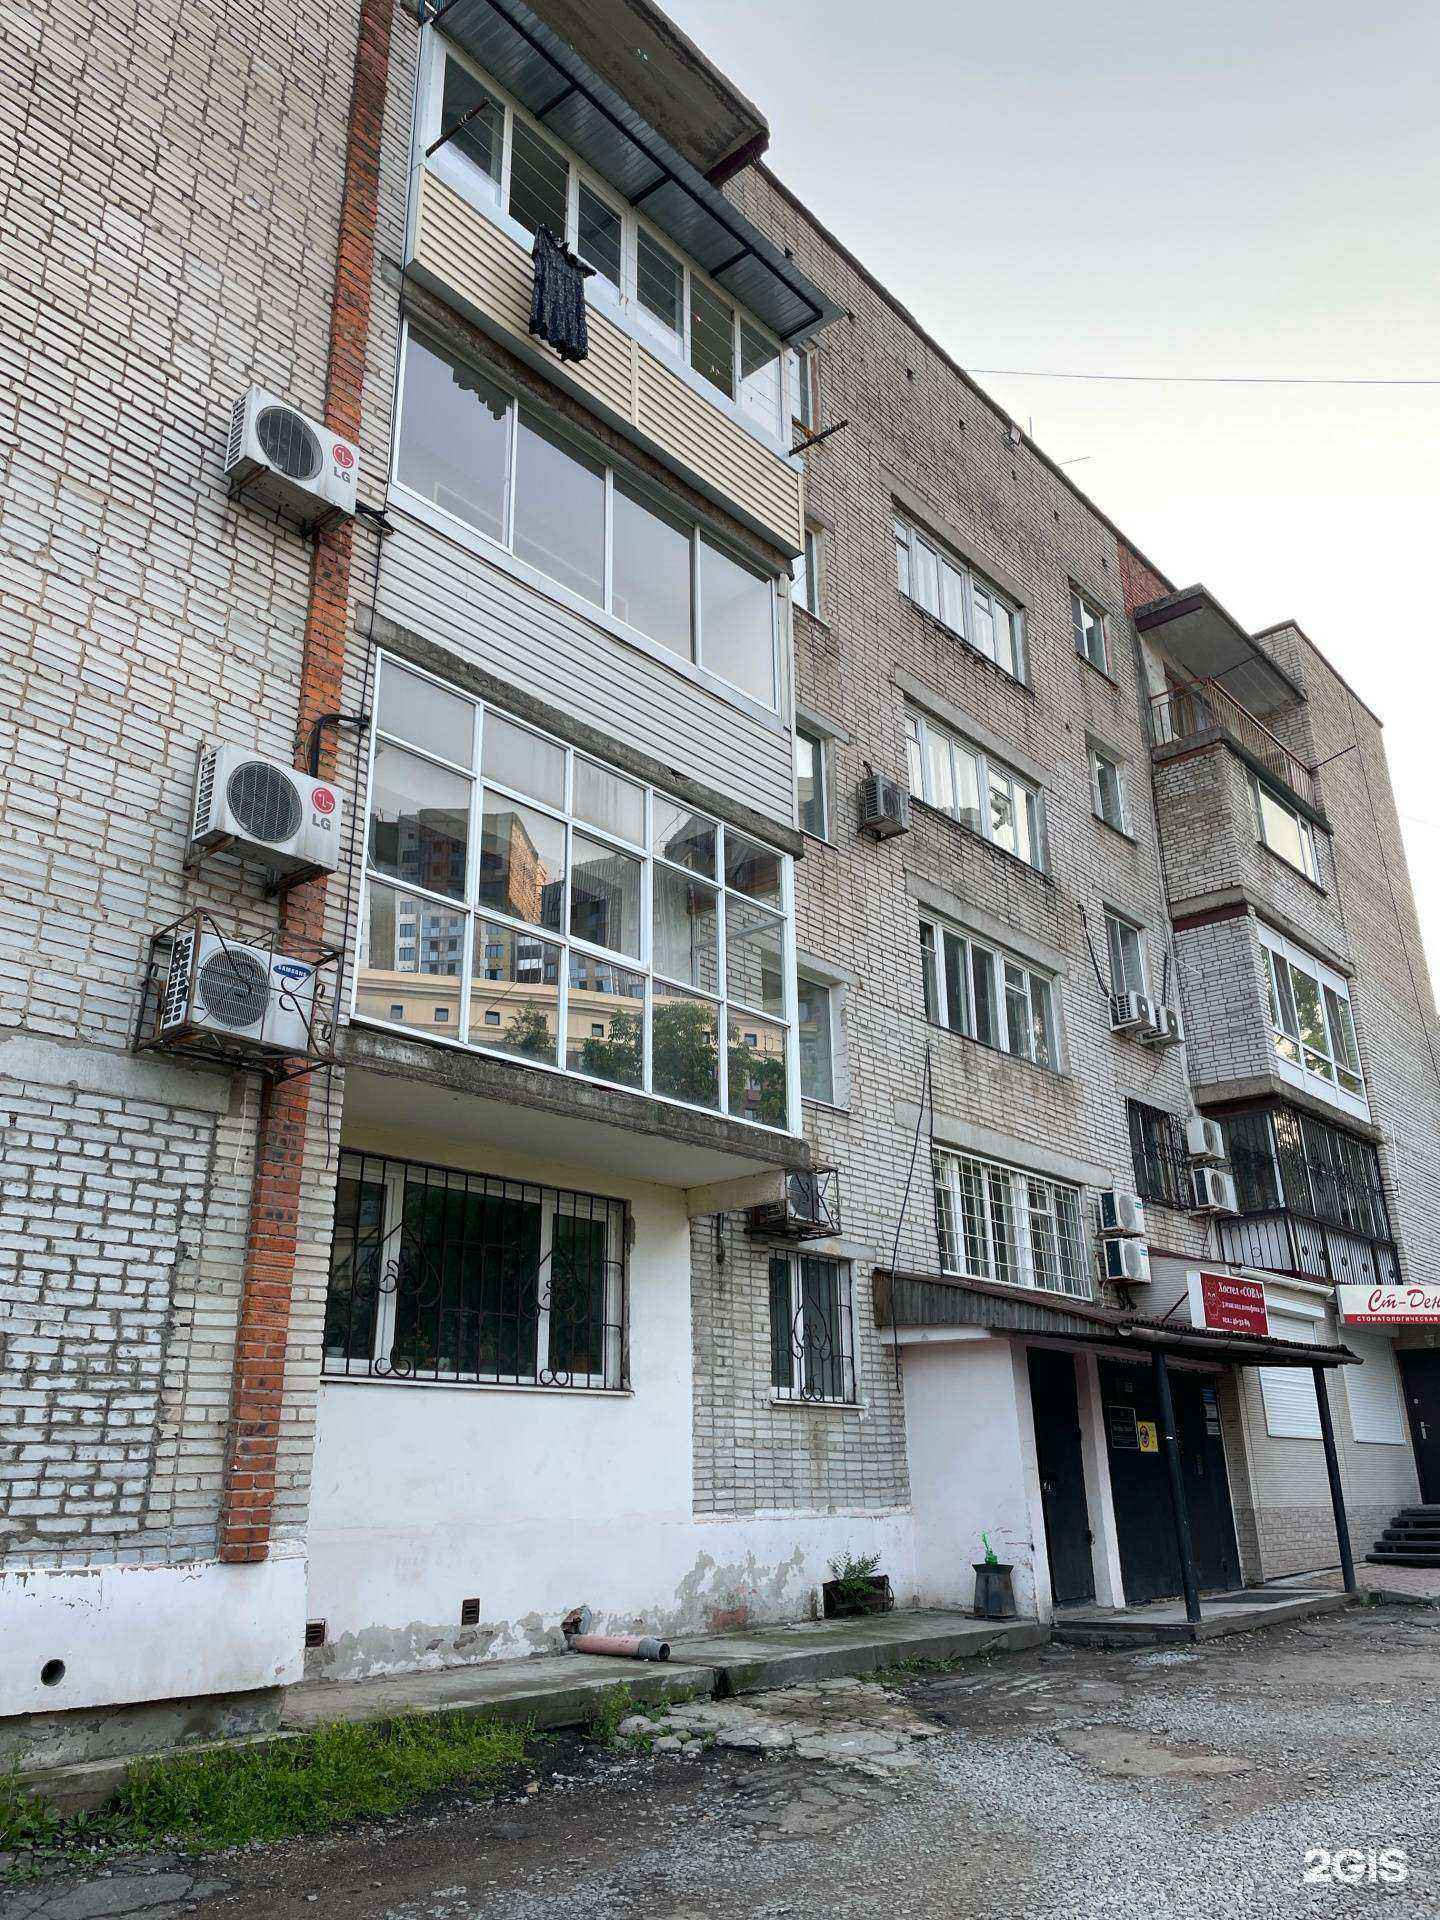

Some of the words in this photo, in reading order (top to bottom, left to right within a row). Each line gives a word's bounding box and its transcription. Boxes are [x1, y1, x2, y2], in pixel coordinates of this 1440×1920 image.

[333, 466, 351, 484] LG
[312, 813, 331, 831] LG
[277, 964, 308, 978] SAMSUNG
